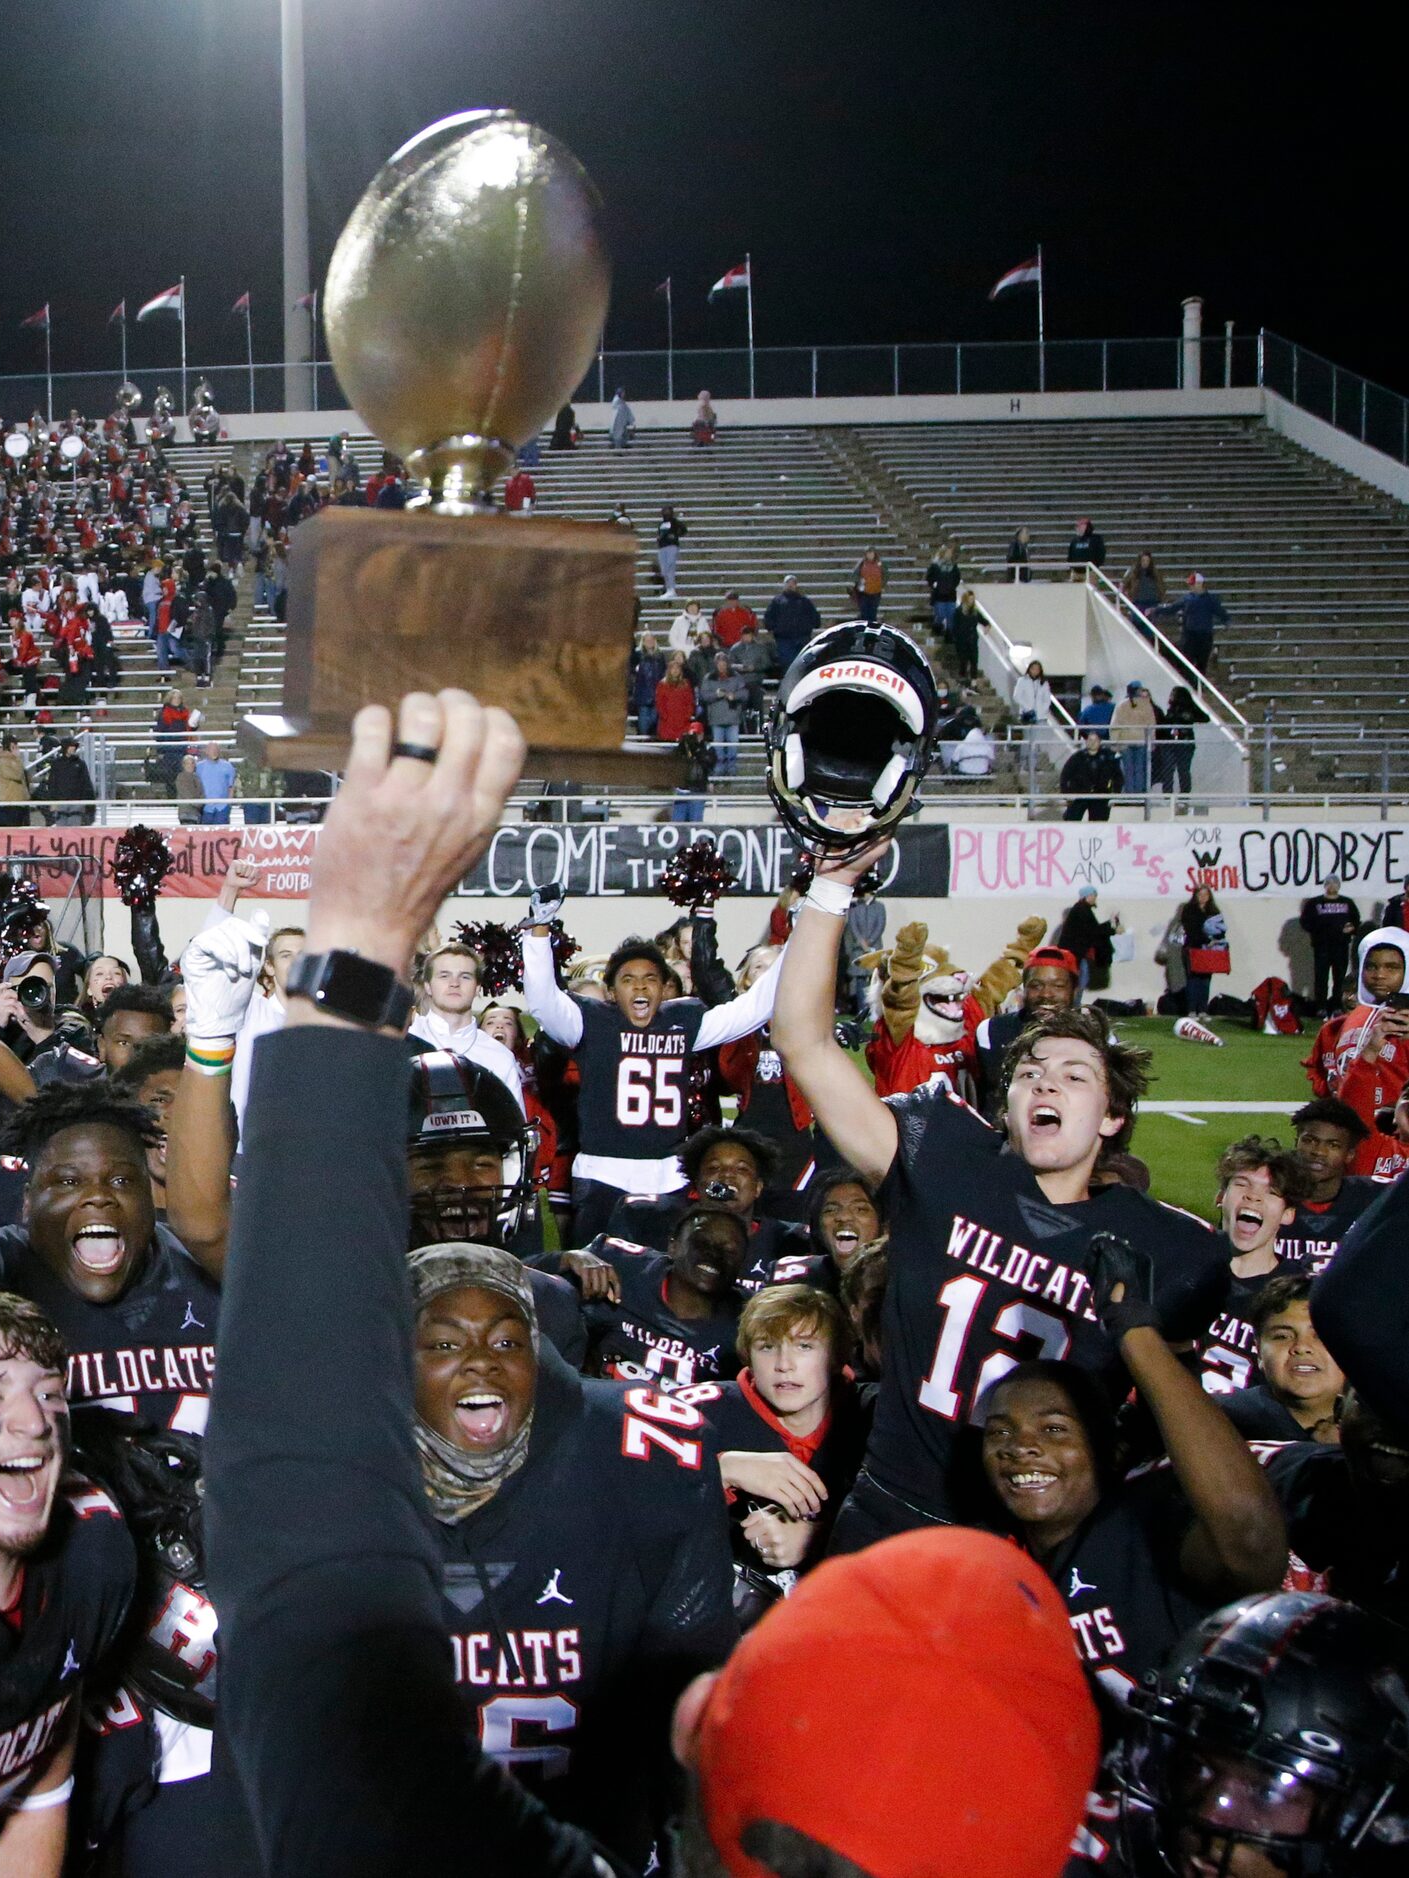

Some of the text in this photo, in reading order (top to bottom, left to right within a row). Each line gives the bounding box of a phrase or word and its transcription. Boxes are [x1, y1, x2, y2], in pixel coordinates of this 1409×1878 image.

[1010, 398, 1021, 413] H
[819, 664, 906, 695] Riddell
[637, 826, 680, 849] TO
[1184, 826, 1222, 847] YOUR
[951, 828, 1071, 893] PUCKER
[1078, 837, 1103, 862] UP
[1239, 828, 1404, 892] GOODBYE
[1071, 861, 1116, 885] AND
[619, 1031, 687, 1055] WILDCATS
[616, 1056, 684, 1128] 65
